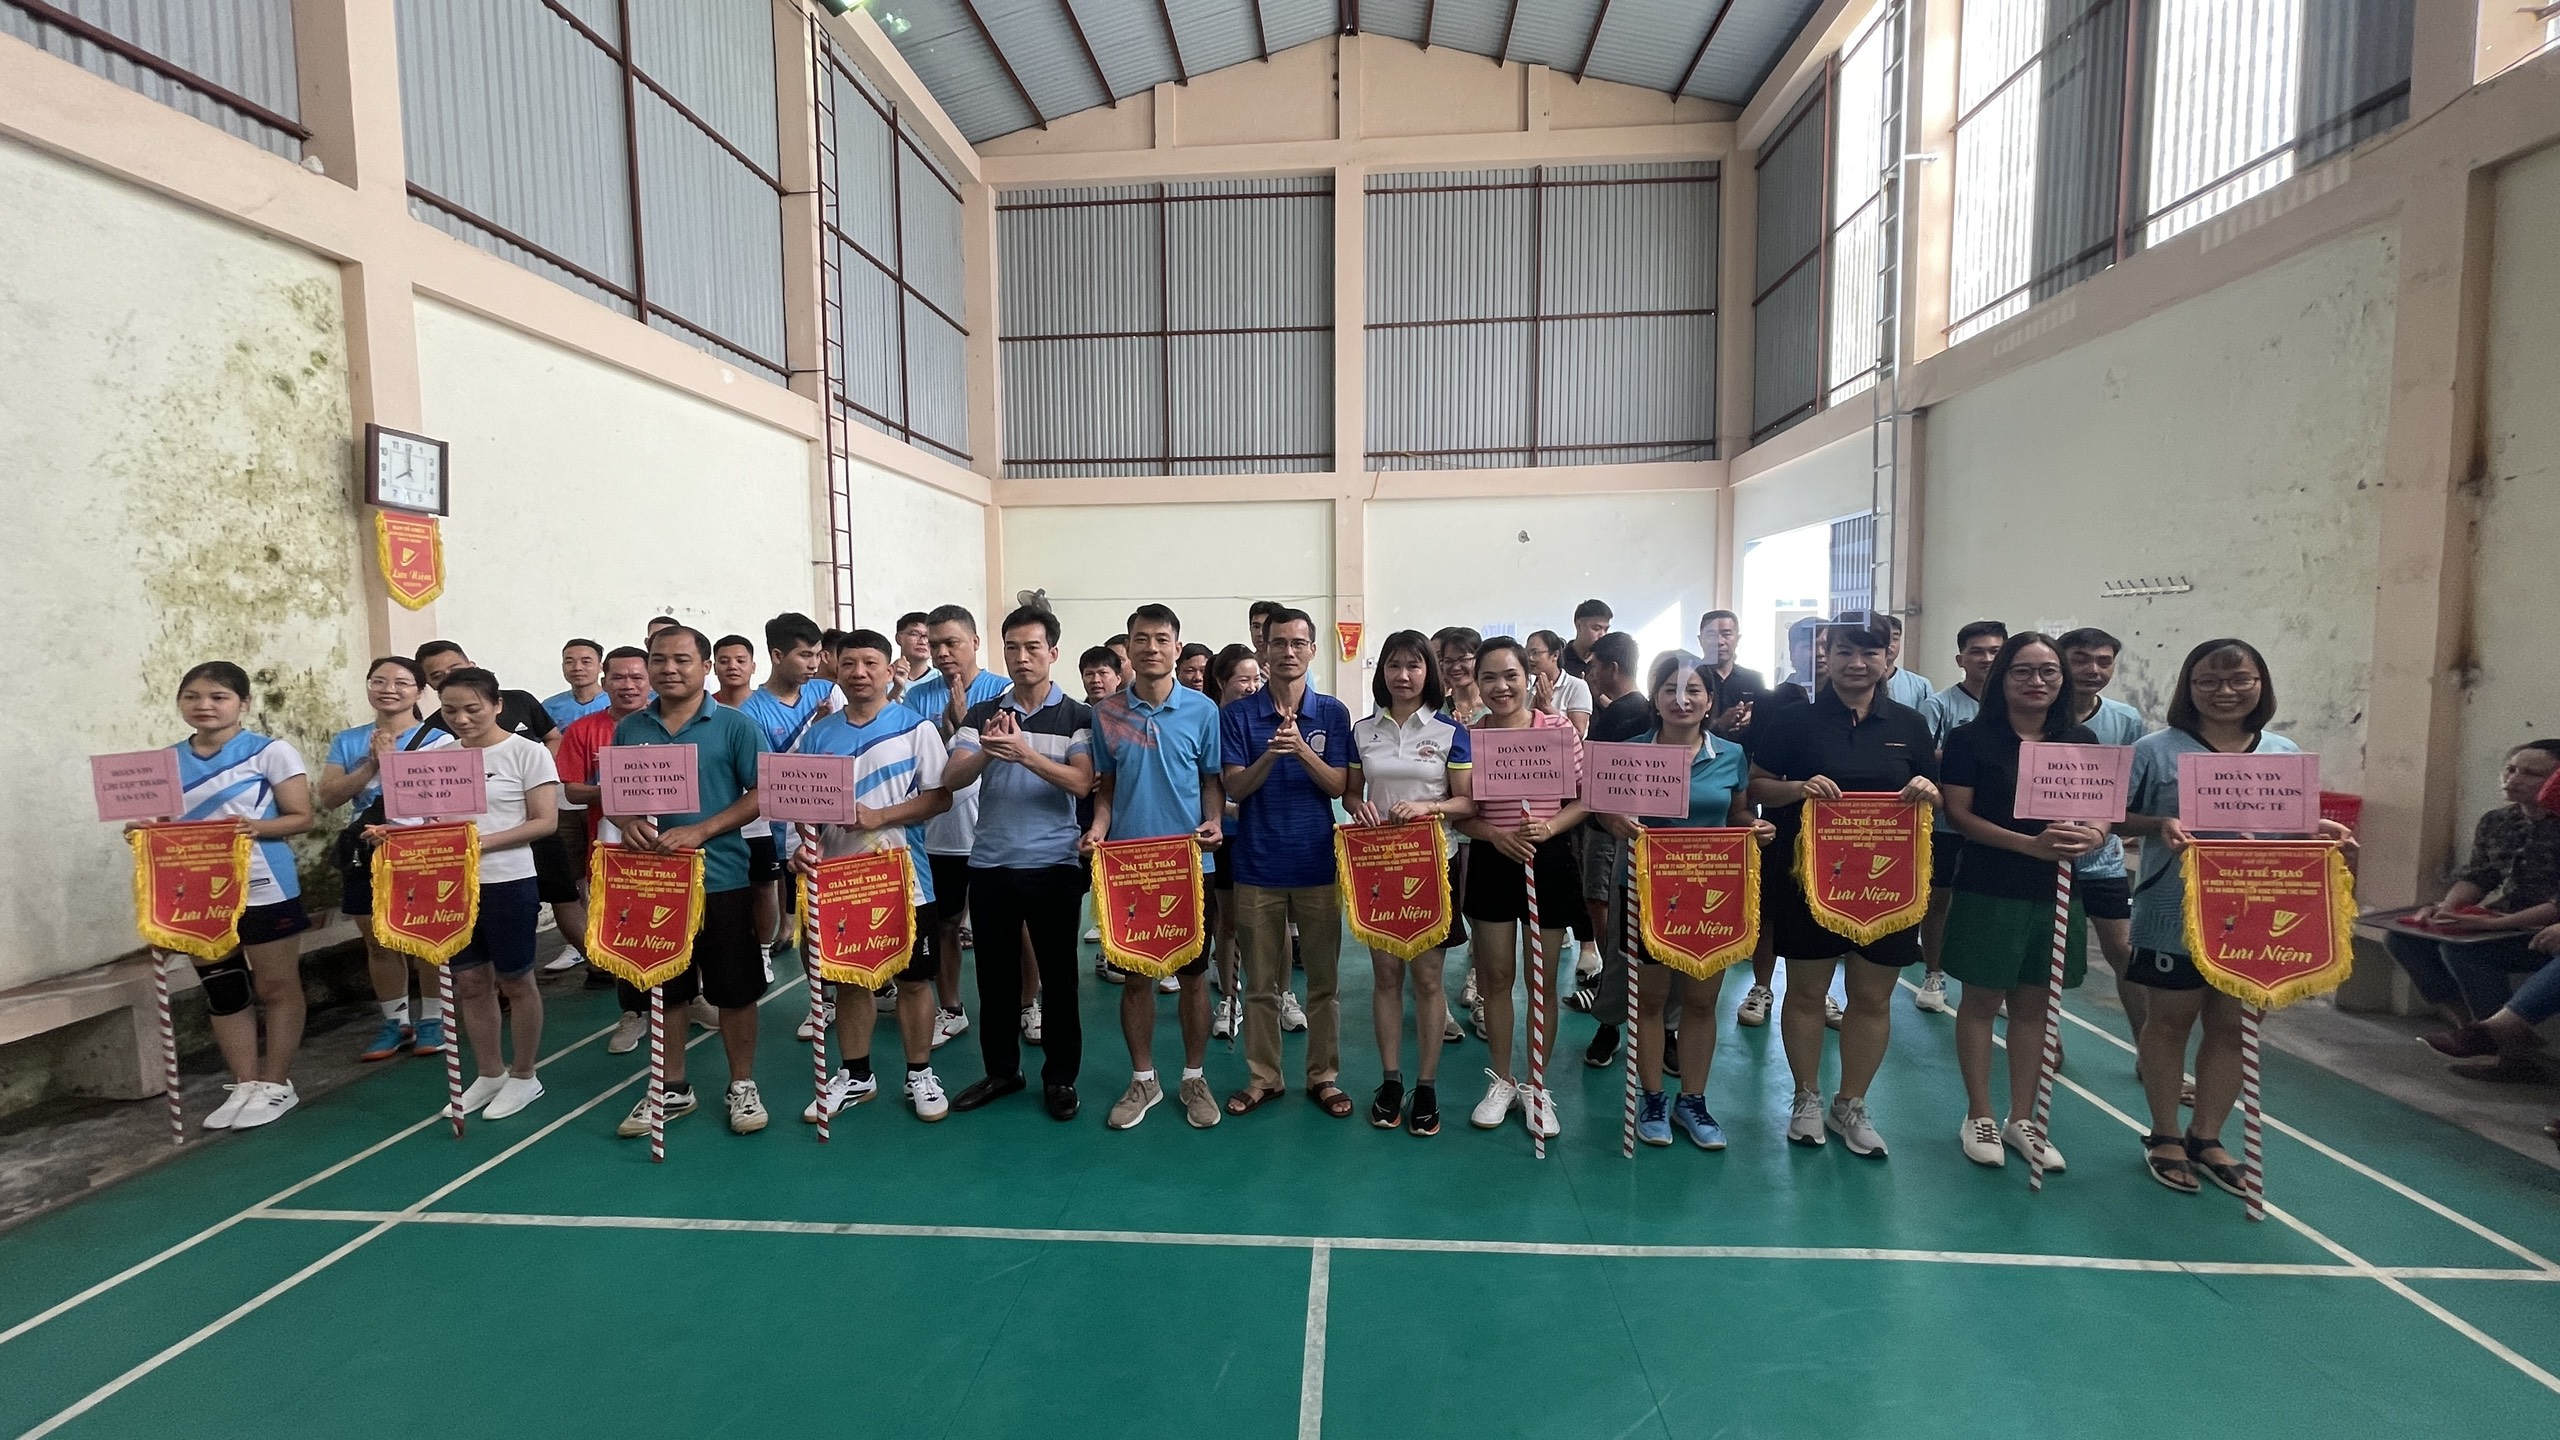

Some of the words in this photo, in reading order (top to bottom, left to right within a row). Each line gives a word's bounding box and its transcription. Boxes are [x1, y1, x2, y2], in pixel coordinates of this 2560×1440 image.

[391, 441, 399, 449] 11
[380, 447, 388, 456] 10
[381, 463, 387, 471] 9
[381, 478, 387, 487] 8
[1519, 759, 1552, 767] THADS
[613, 776, 630, 784] CHI
[653, 774, 686, 782] THADS
[1513, 772, 1530, 780] LAI
[1596, 771, 1616, 780] CHI
[1644, 774, 1682, 784] THADS
[2033, 776, 2052, 784] CHI
[2080, 778, 2115, 786] THADS
[622, 788, 655, 796] PHONG
[770, 783, 787, 791] CHI
[810, 785, 842, 793] THADS
[1607, 786, 1637, 796] THAN
[2197, 787, 2221, 795] CHI
[2256, 787, 2302, 796] THADS
[778, 796, 798, 805] TAM
[1704, 853, 1729, 861] THAO
[865, 873, 888, 883] THAO
